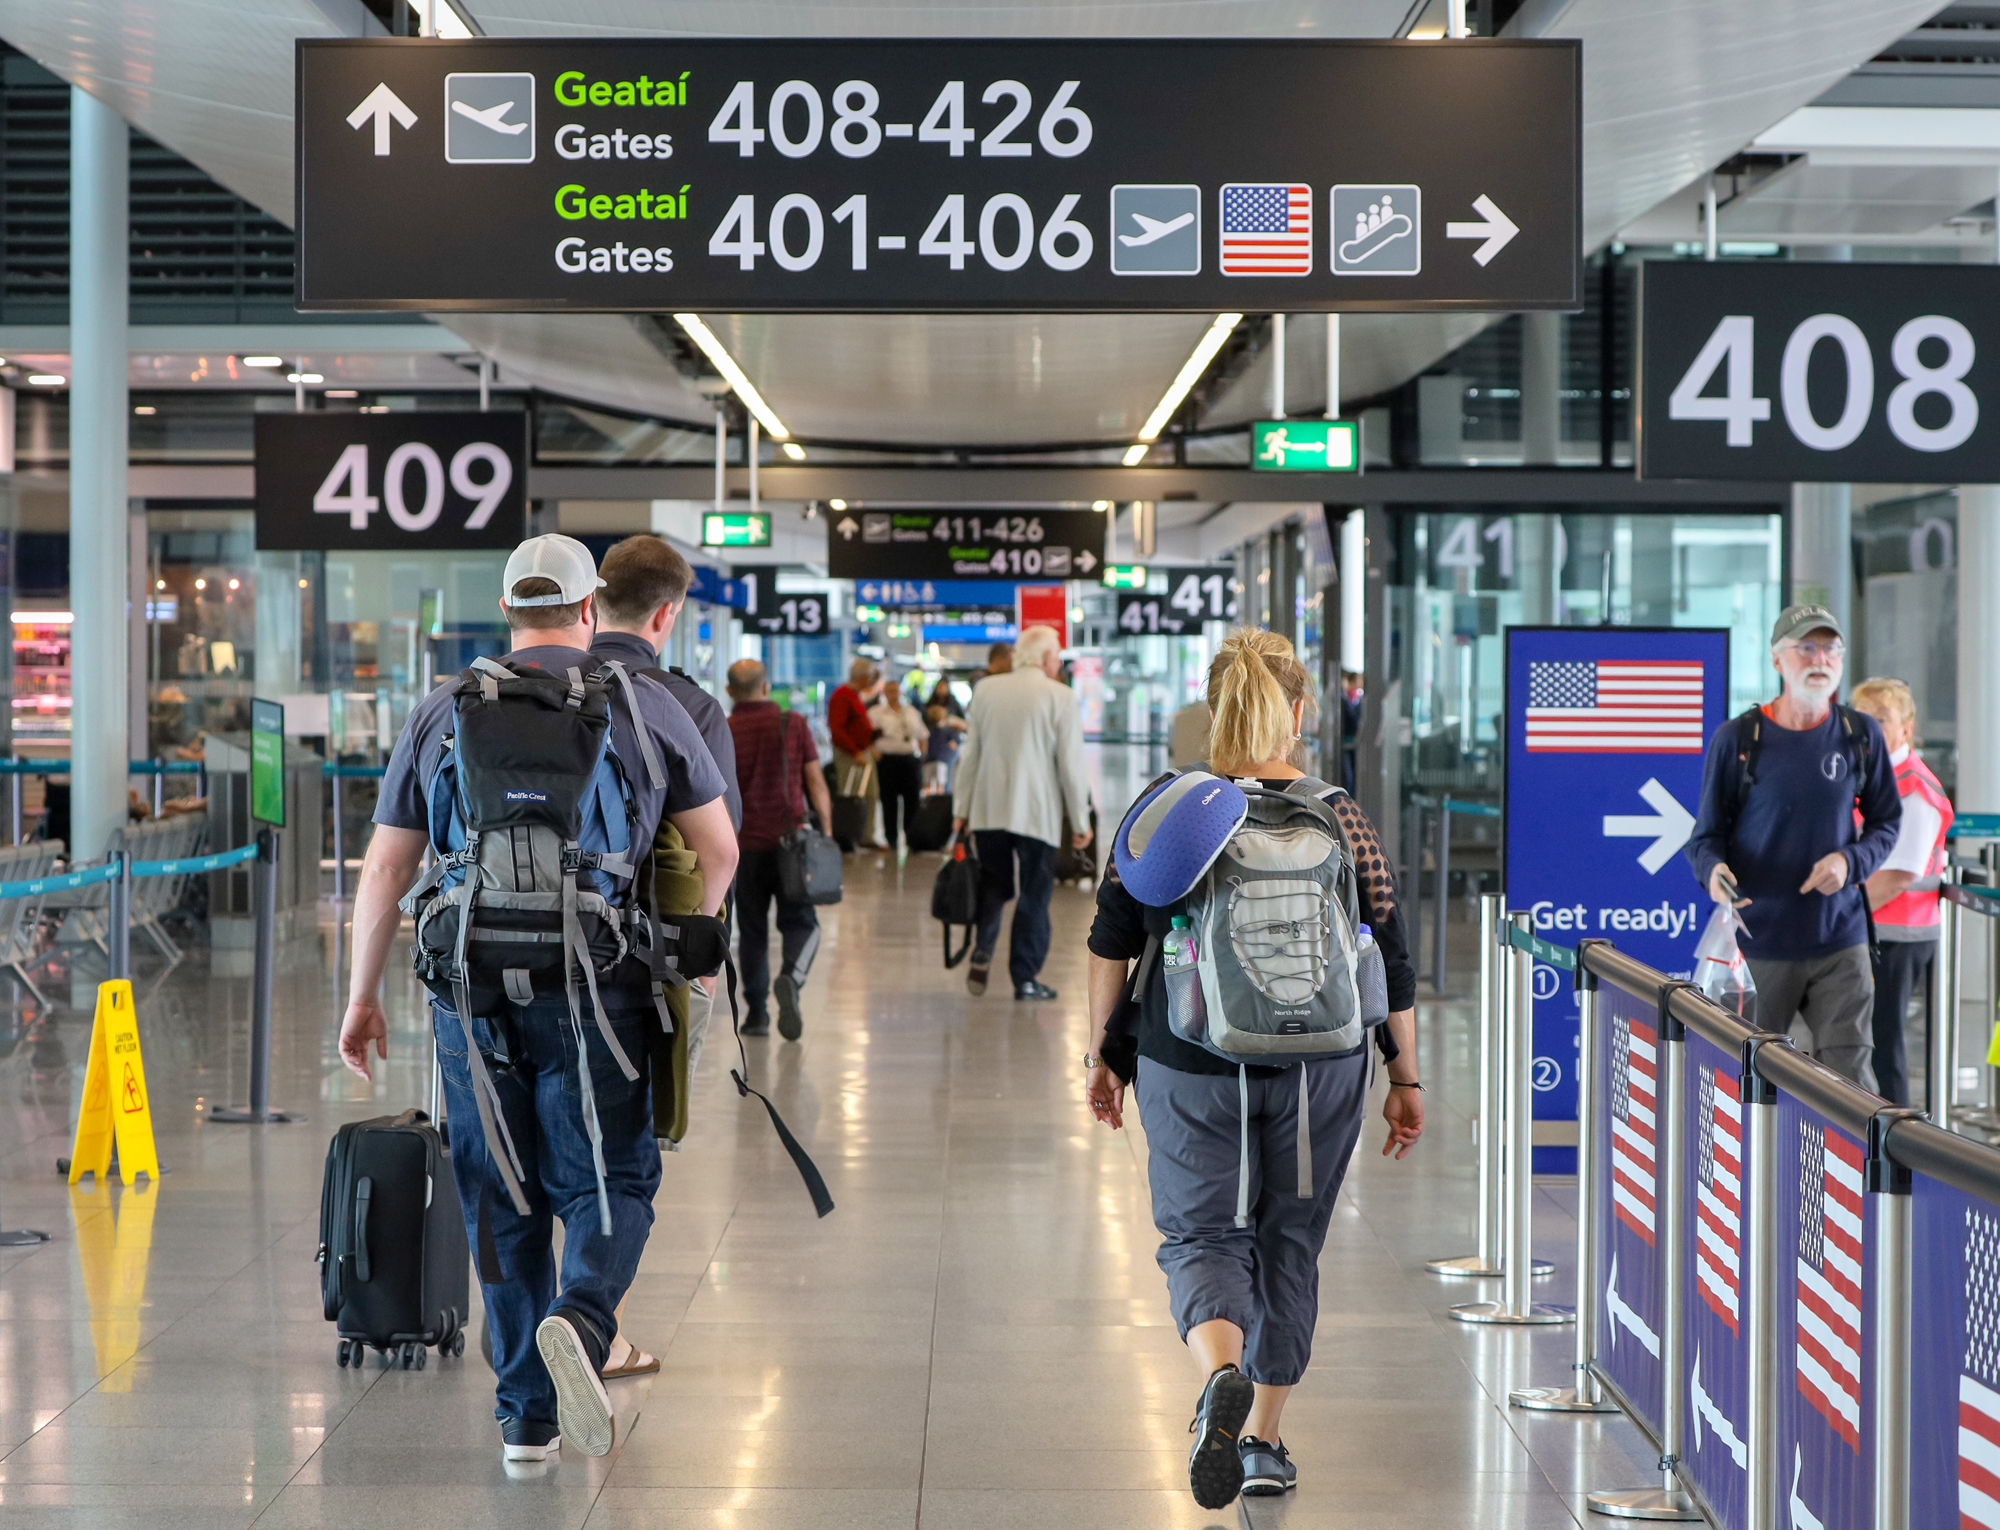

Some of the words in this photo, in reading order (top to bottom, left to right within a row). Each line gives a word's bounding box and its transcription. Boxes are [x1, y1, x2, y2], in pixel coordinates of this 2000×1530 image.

[554, 70, 692, 107] Geataí
[554, 123, 674, 161] Gates
[708, 79, 1093, 159] 408-426
[554, 183, 692, 221] Geataí
[554, 236, 674, 274] Gates
[708, 193, 1093, 272] 401-406
[1668, 313, 1979, 453] 408
[313, 442, 512, 531] 409
[932, 516, 1045, 543] 411-426
[989, 548, 1042, 575] 410
[507, 791, 529, 799] Pacific
[1531, 900, 1588, 931] Get
[1599, 900, 1697, 938] ready!
[1293, 1009, 1311, 1017] Ridge
